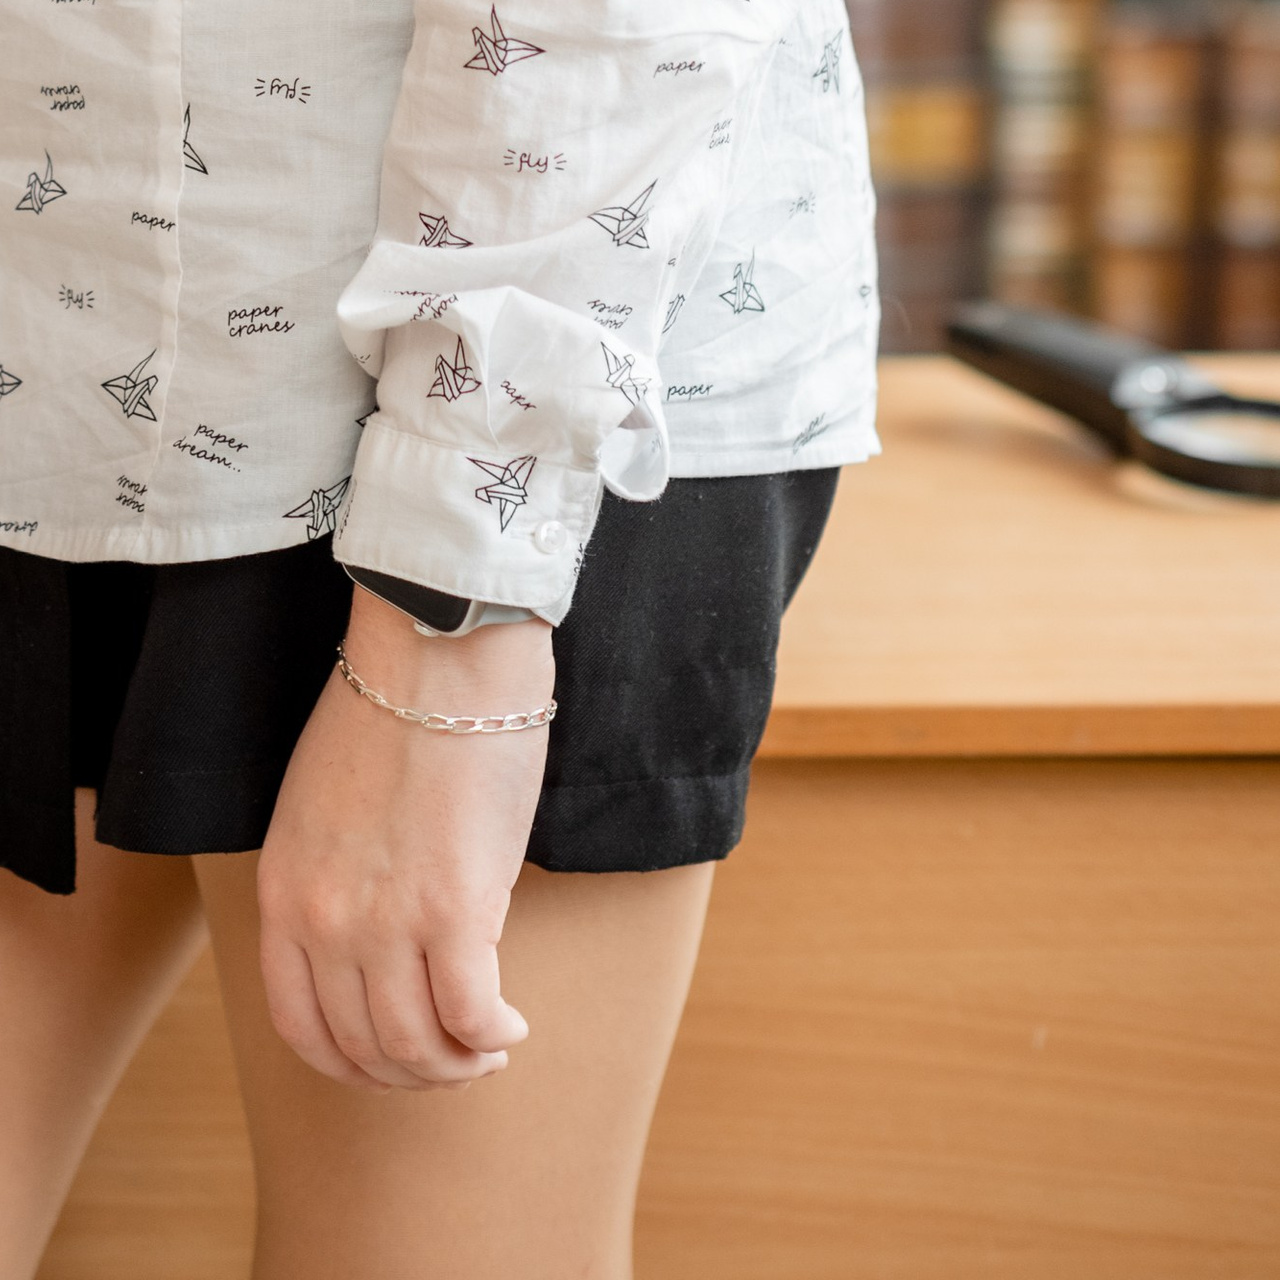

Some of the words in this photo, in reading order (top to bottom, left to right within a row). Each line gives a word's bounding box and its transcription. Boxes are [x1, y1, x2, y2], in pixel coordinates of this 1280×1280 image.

[653, 60, 707, 78] paper
[269, 77, 300, 100] fly
[517, 151, 549, 173] fly
[130, 211, 176, 232] paper
[65, 288, 84, 310] fly
[227, 305, 283, 326] paper
[228, 320, 295, 338] cranes
[666, 383, 714, 401] paper
[193, 423, 249, 453] paper
[172, 436, 242, 473] dream...
